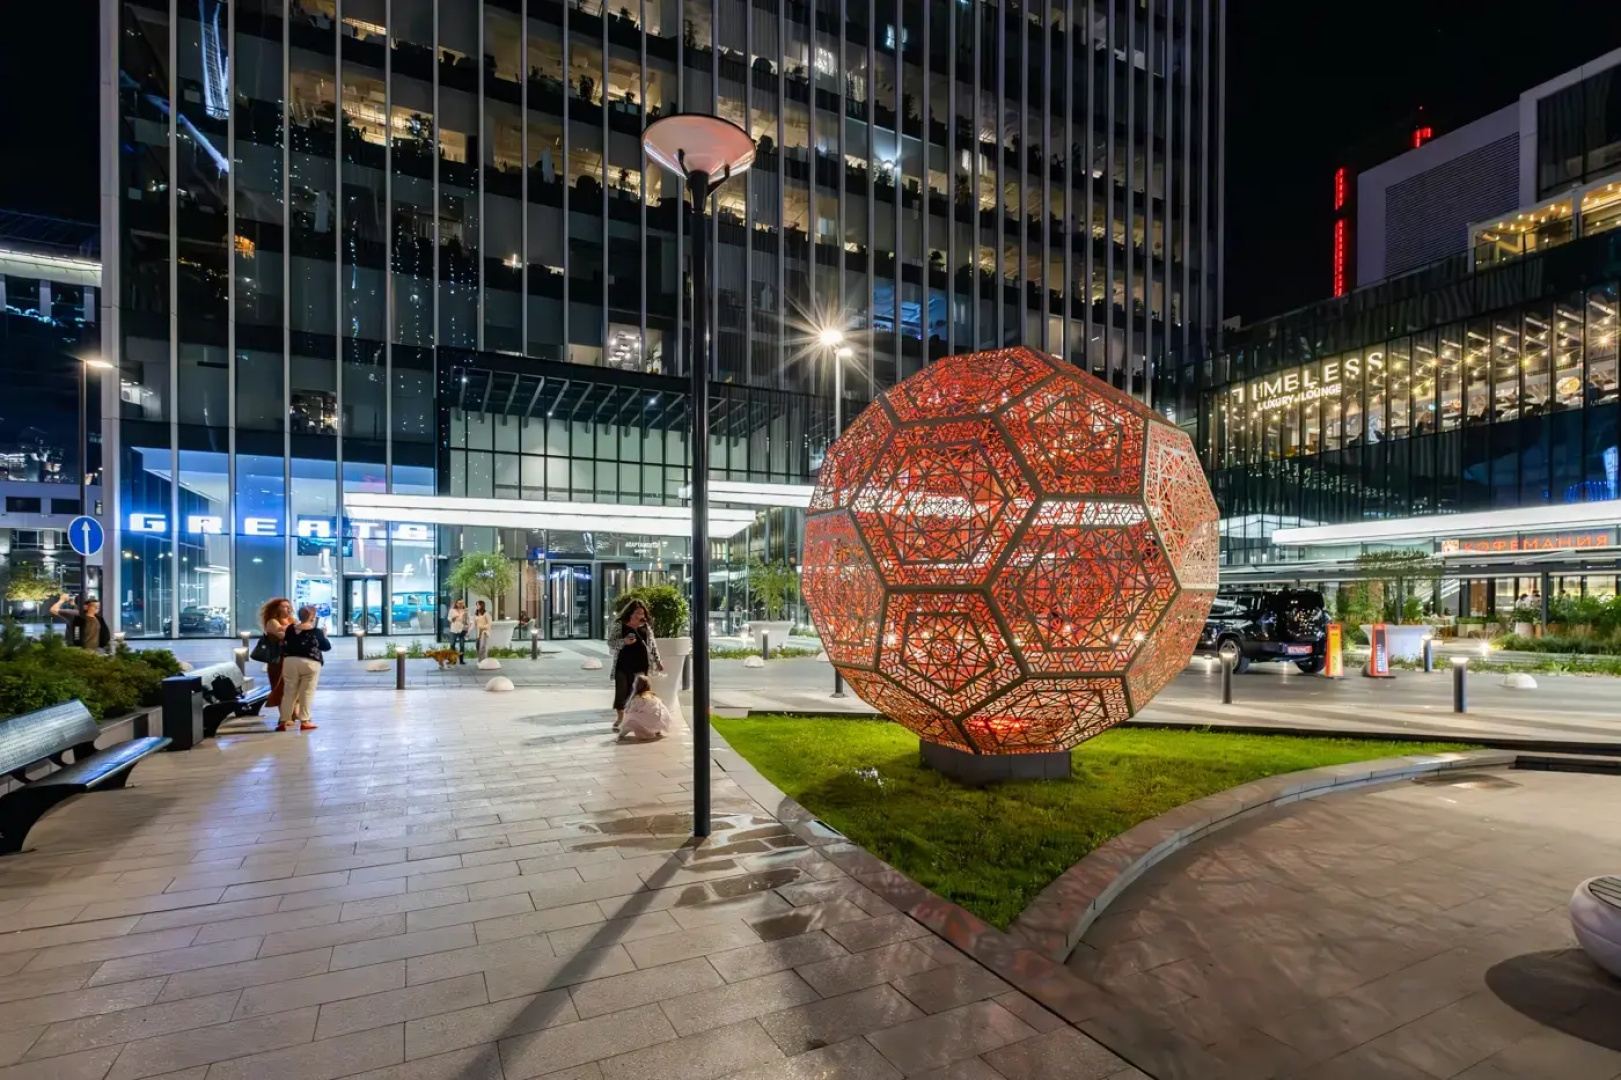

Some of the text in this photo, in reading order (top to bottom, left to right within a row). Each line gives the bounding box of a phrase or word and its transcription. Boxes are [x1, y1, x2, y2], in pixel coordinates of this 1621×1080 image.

[1231, 352, 1383, 404] TIMELESS
[1257, 382, 1342, 411] LUXURY LOUNGE
[1463, 534, 1608, 552] КОФЕМАНИЯ
